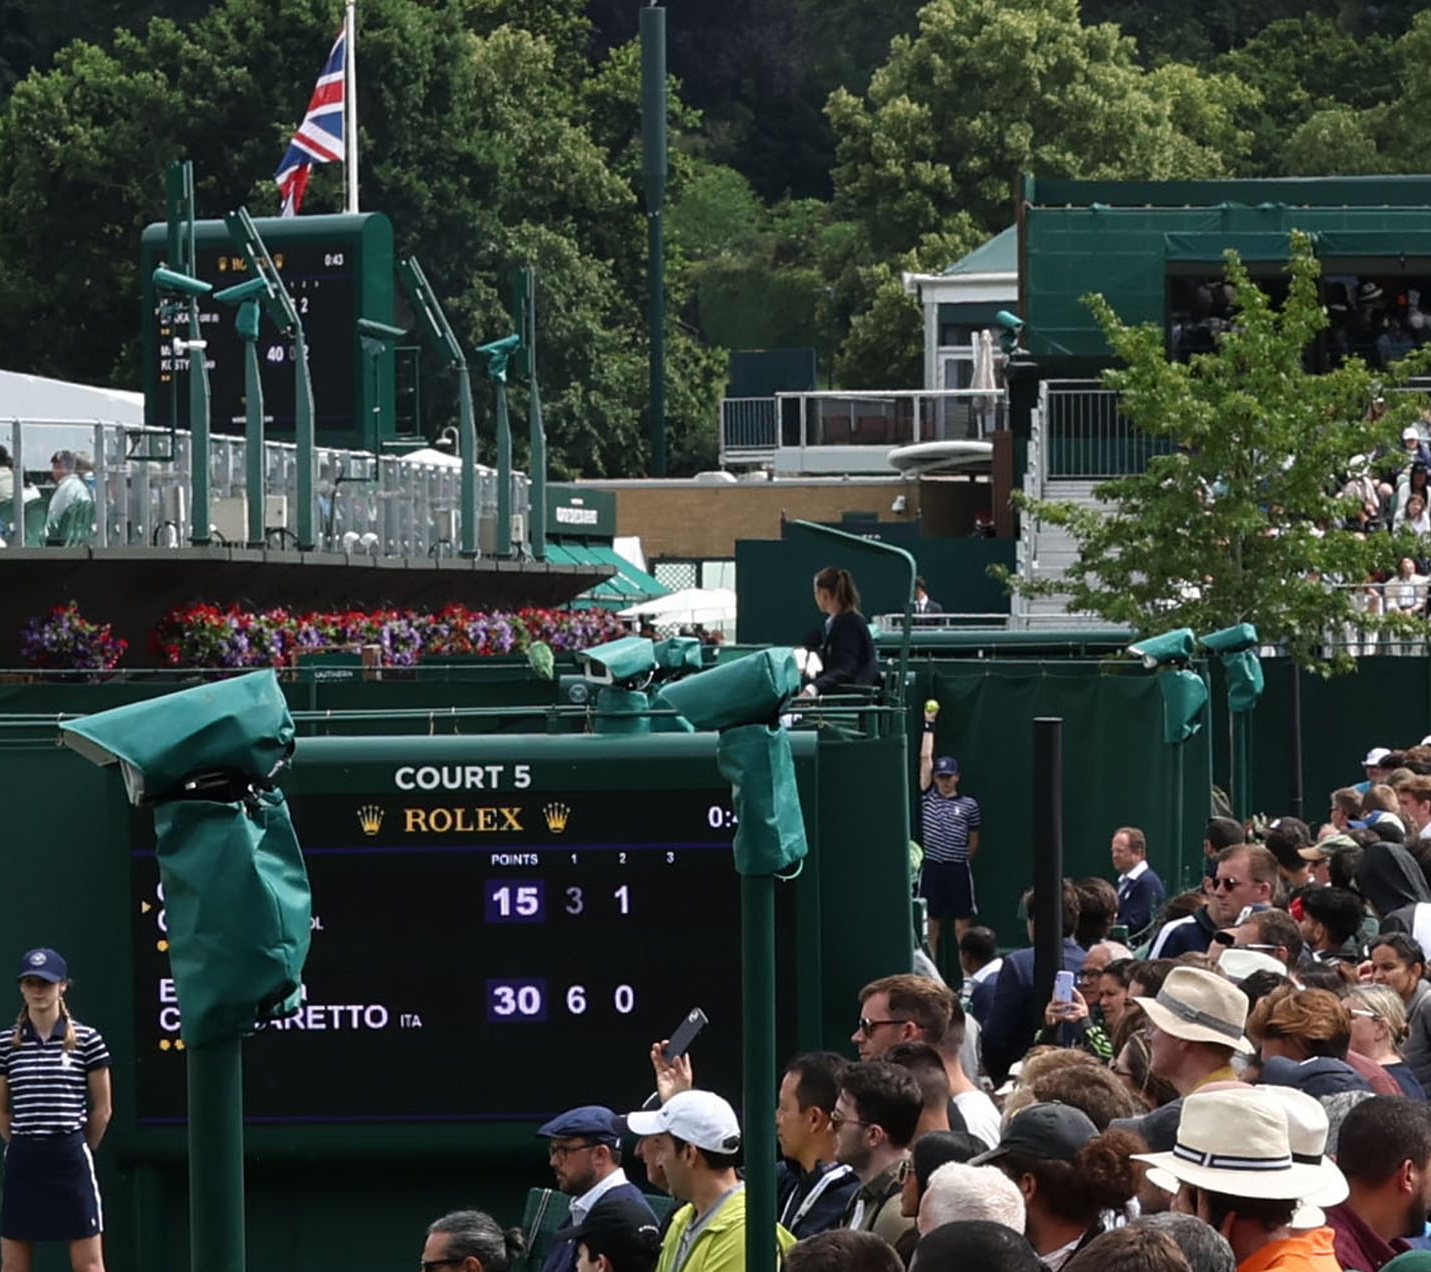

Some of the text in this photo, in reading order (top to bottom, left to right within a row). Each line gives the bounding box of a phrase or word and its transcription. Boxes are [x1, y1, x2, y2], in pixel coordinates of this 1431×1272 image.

[267, 347, 284, 361] 40
[395, 764, 532, 790] COURT 5
[404, 807, 524, 833] ROLEX
[491, 851, 675, 866] POINTS 1 2 3
[492, 884, 629, 916] 15 3 1
[493, 983, 635, 1016] 30 6 0
[400, 1014, 423, 1028] ITA
